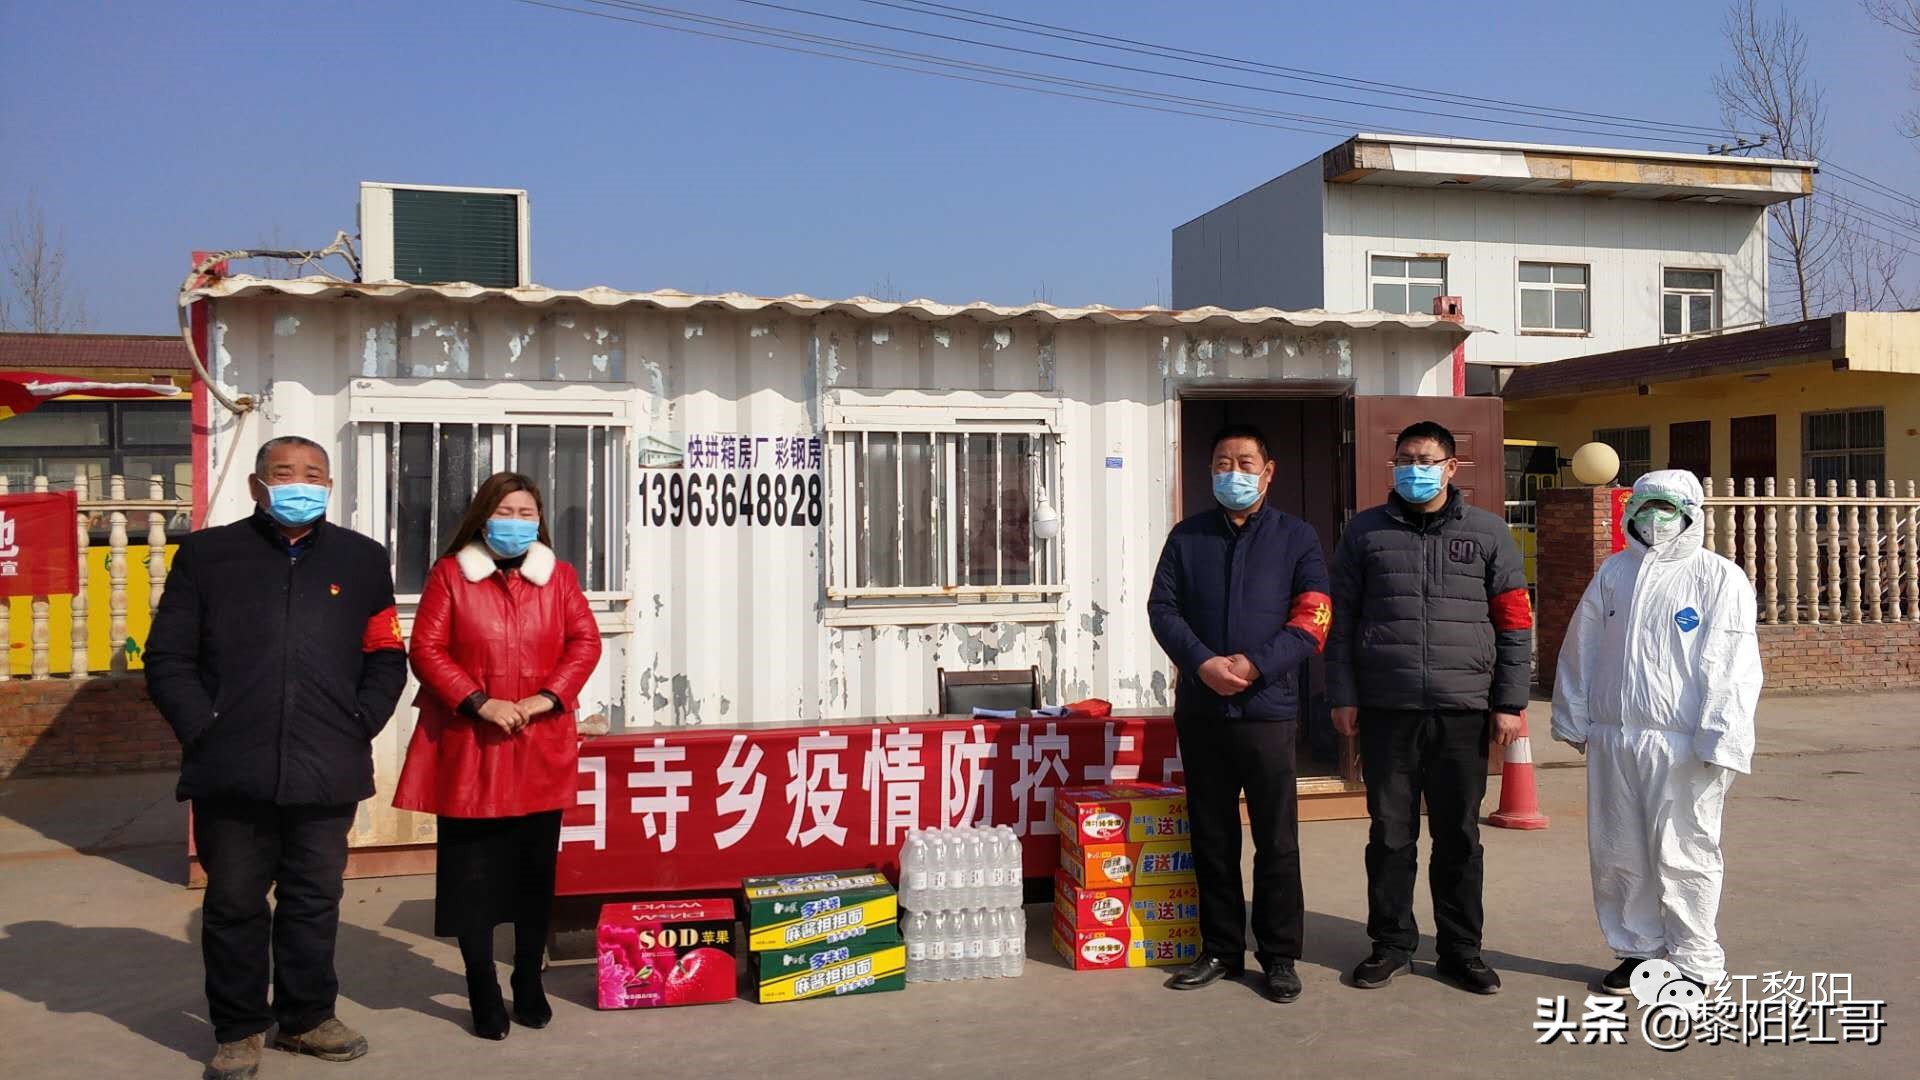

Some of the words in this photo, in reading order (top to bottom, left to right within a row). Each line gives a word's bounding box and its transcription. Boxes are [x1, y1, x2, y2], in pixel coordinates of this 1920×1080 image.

[688, 434, 768, 469] 快拼箱房厂
[775, 436, 822, 470] 彩钢房
[638, 472, 822, 527] 13963648828
[1449, 539, 1475, 564] 90
[639, 928, 699, 950] SOD
[701, 930, 729, 945] 苹果
